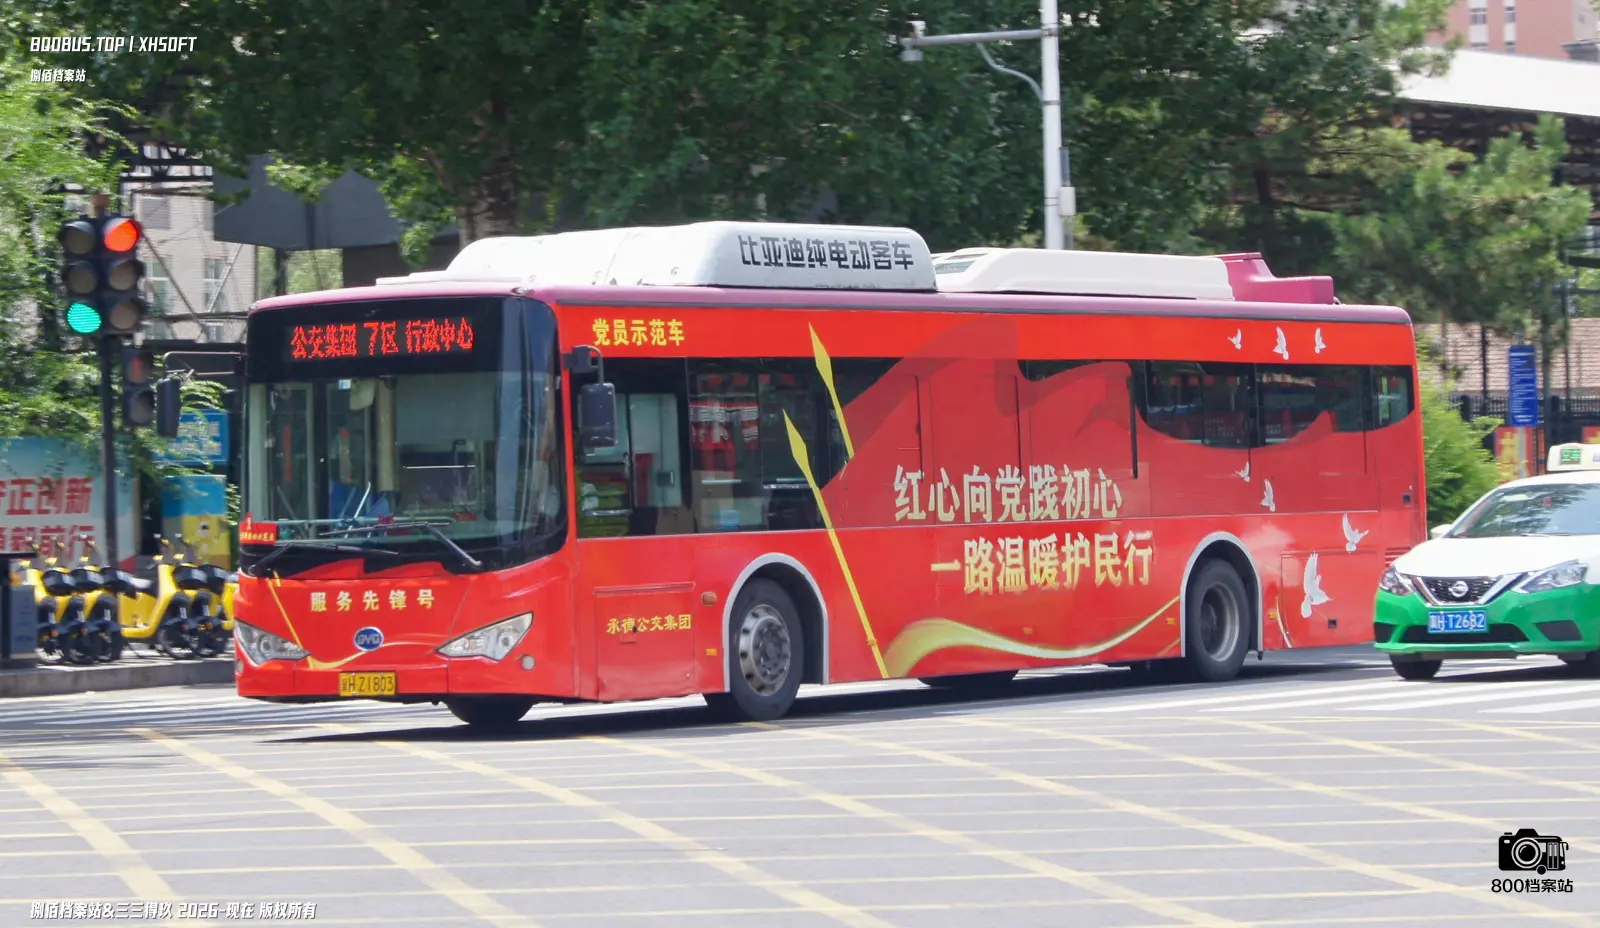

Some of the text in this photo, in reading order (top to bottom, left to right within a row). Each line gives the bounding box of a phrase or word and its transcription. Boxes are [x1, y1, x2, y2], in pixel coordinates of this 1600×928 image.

[738, 235, 914, 270] 比亚迪纯电动客车
[290, 323, 357, 359] 公交集团
[405, 316, 475, 353] 行政中心
[592, 318, 685, 346] 党员示范车
[893, 464, 1122, 522] 红心向党践初心
[931, 530, 1153, 595] 一路温暖护民行
[310, 589, 435, 612] 服务先锋号
[606, 614, 692, 634] 承德公交集团
